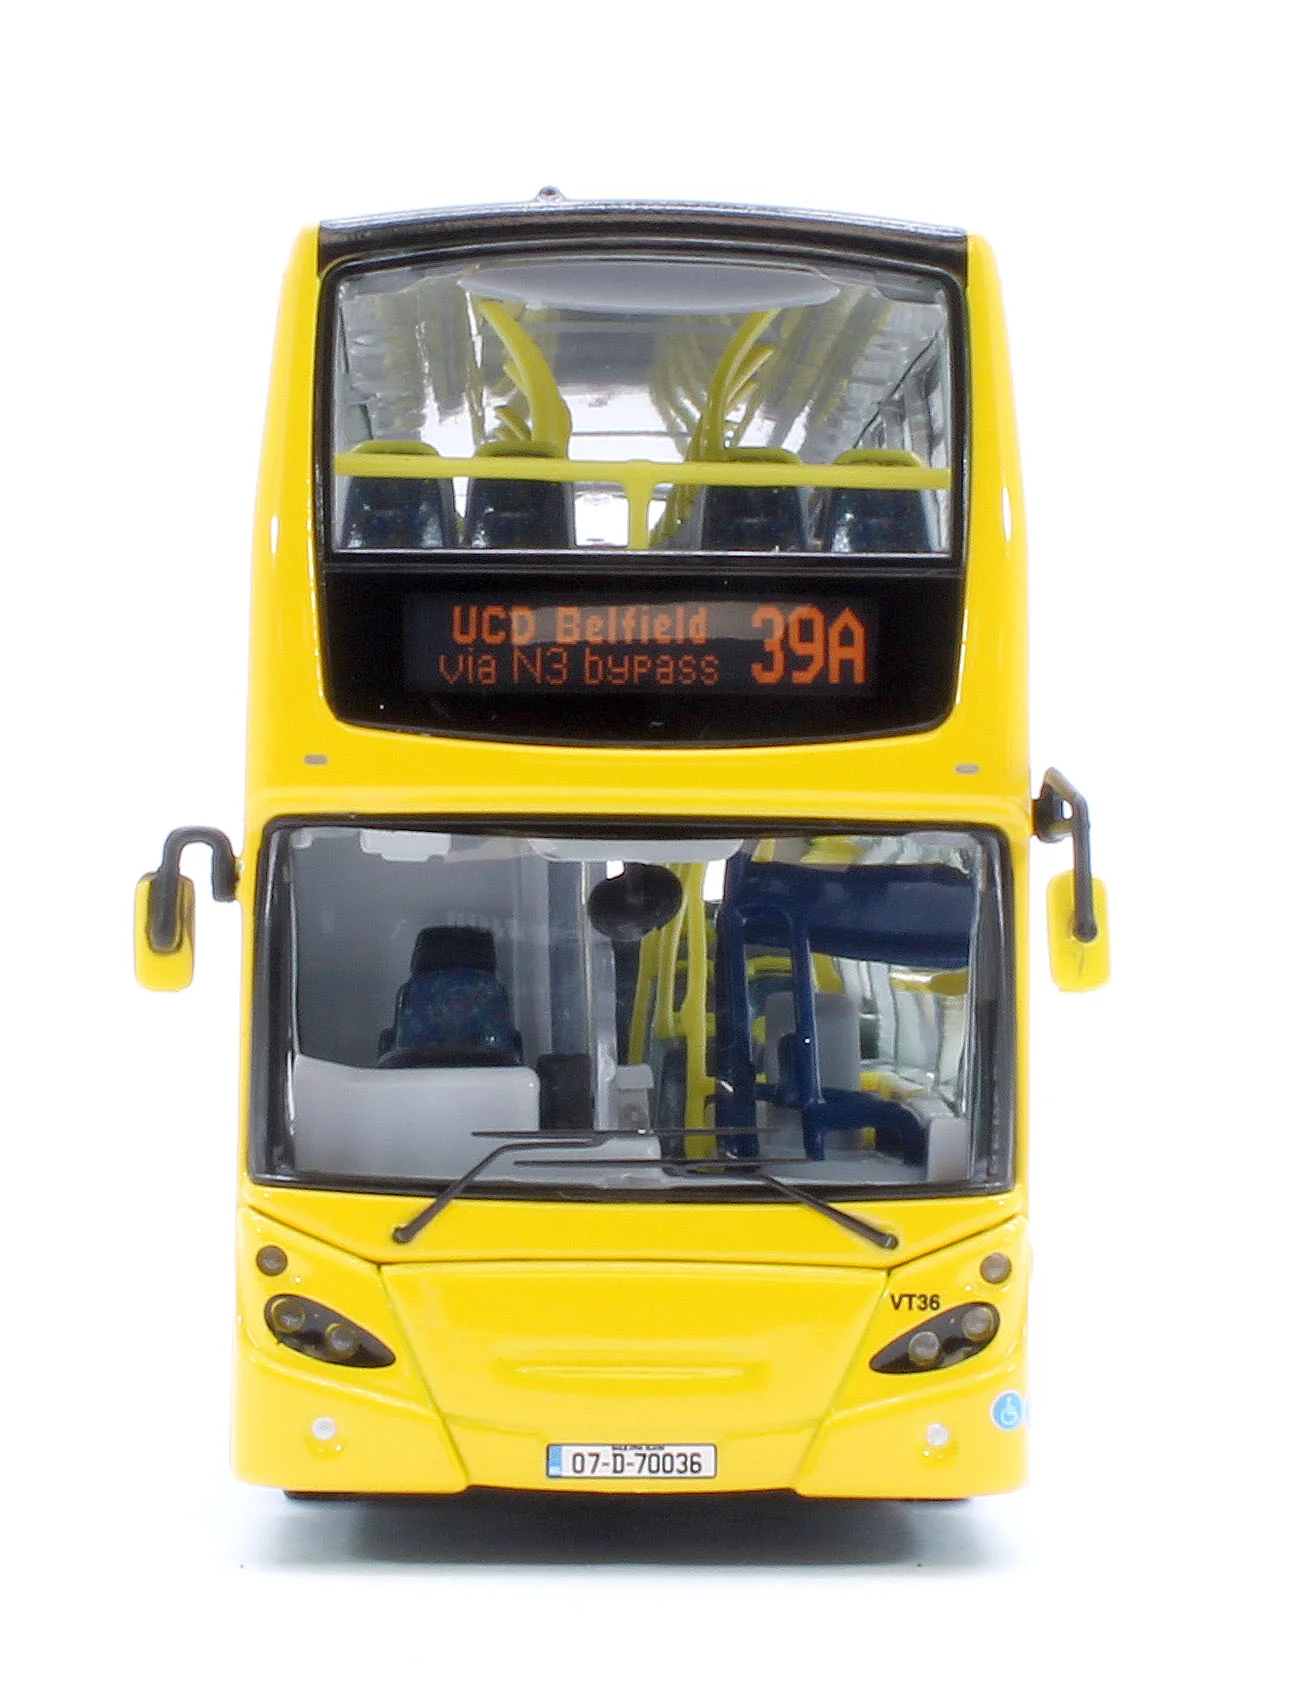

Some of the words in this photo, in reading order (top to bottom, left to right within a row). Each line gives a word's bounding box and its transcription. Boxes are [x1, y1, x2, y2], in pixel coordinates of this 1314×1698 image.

[452, 605, 535, 645] UCD
[555, 606, 708, 645] Belfield
[751, 605, 867, 685] 39A
[438, 647, 498, 685] via
[513, 647, 568, 685] N3
[584, 647, 719, 686] bypass
[890, 1294, 941, 1311] VT36
[572, 1452, 703, 1475] 07-D-70036
